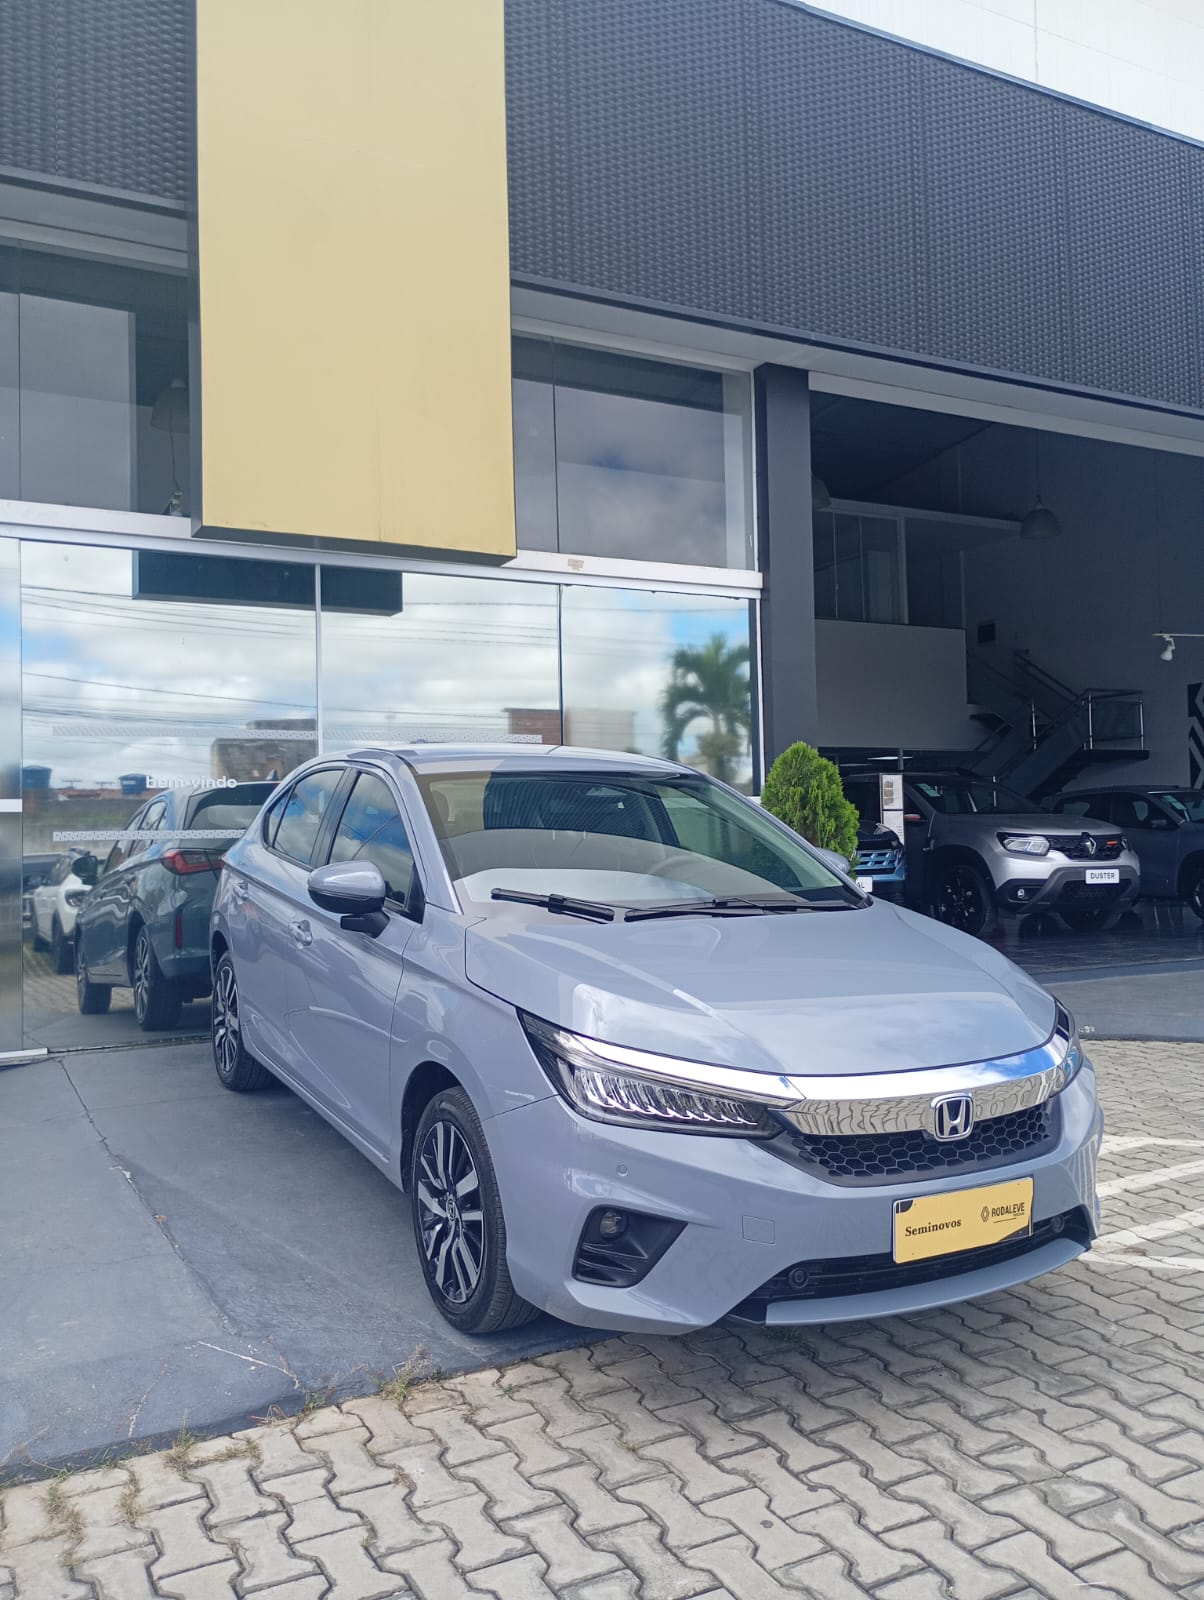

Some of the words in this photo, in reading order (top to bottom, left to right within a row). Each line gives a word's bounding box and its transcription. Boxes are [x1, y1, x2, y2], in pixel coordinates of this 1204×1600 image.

[145, 775, 238, 789] bem-vindo
[1090, 872, 1115, 880] DUSTER
[991, 1202, 1025, 1217] RODALEVE
[904, 1219, 962, 1237] Seminovos
